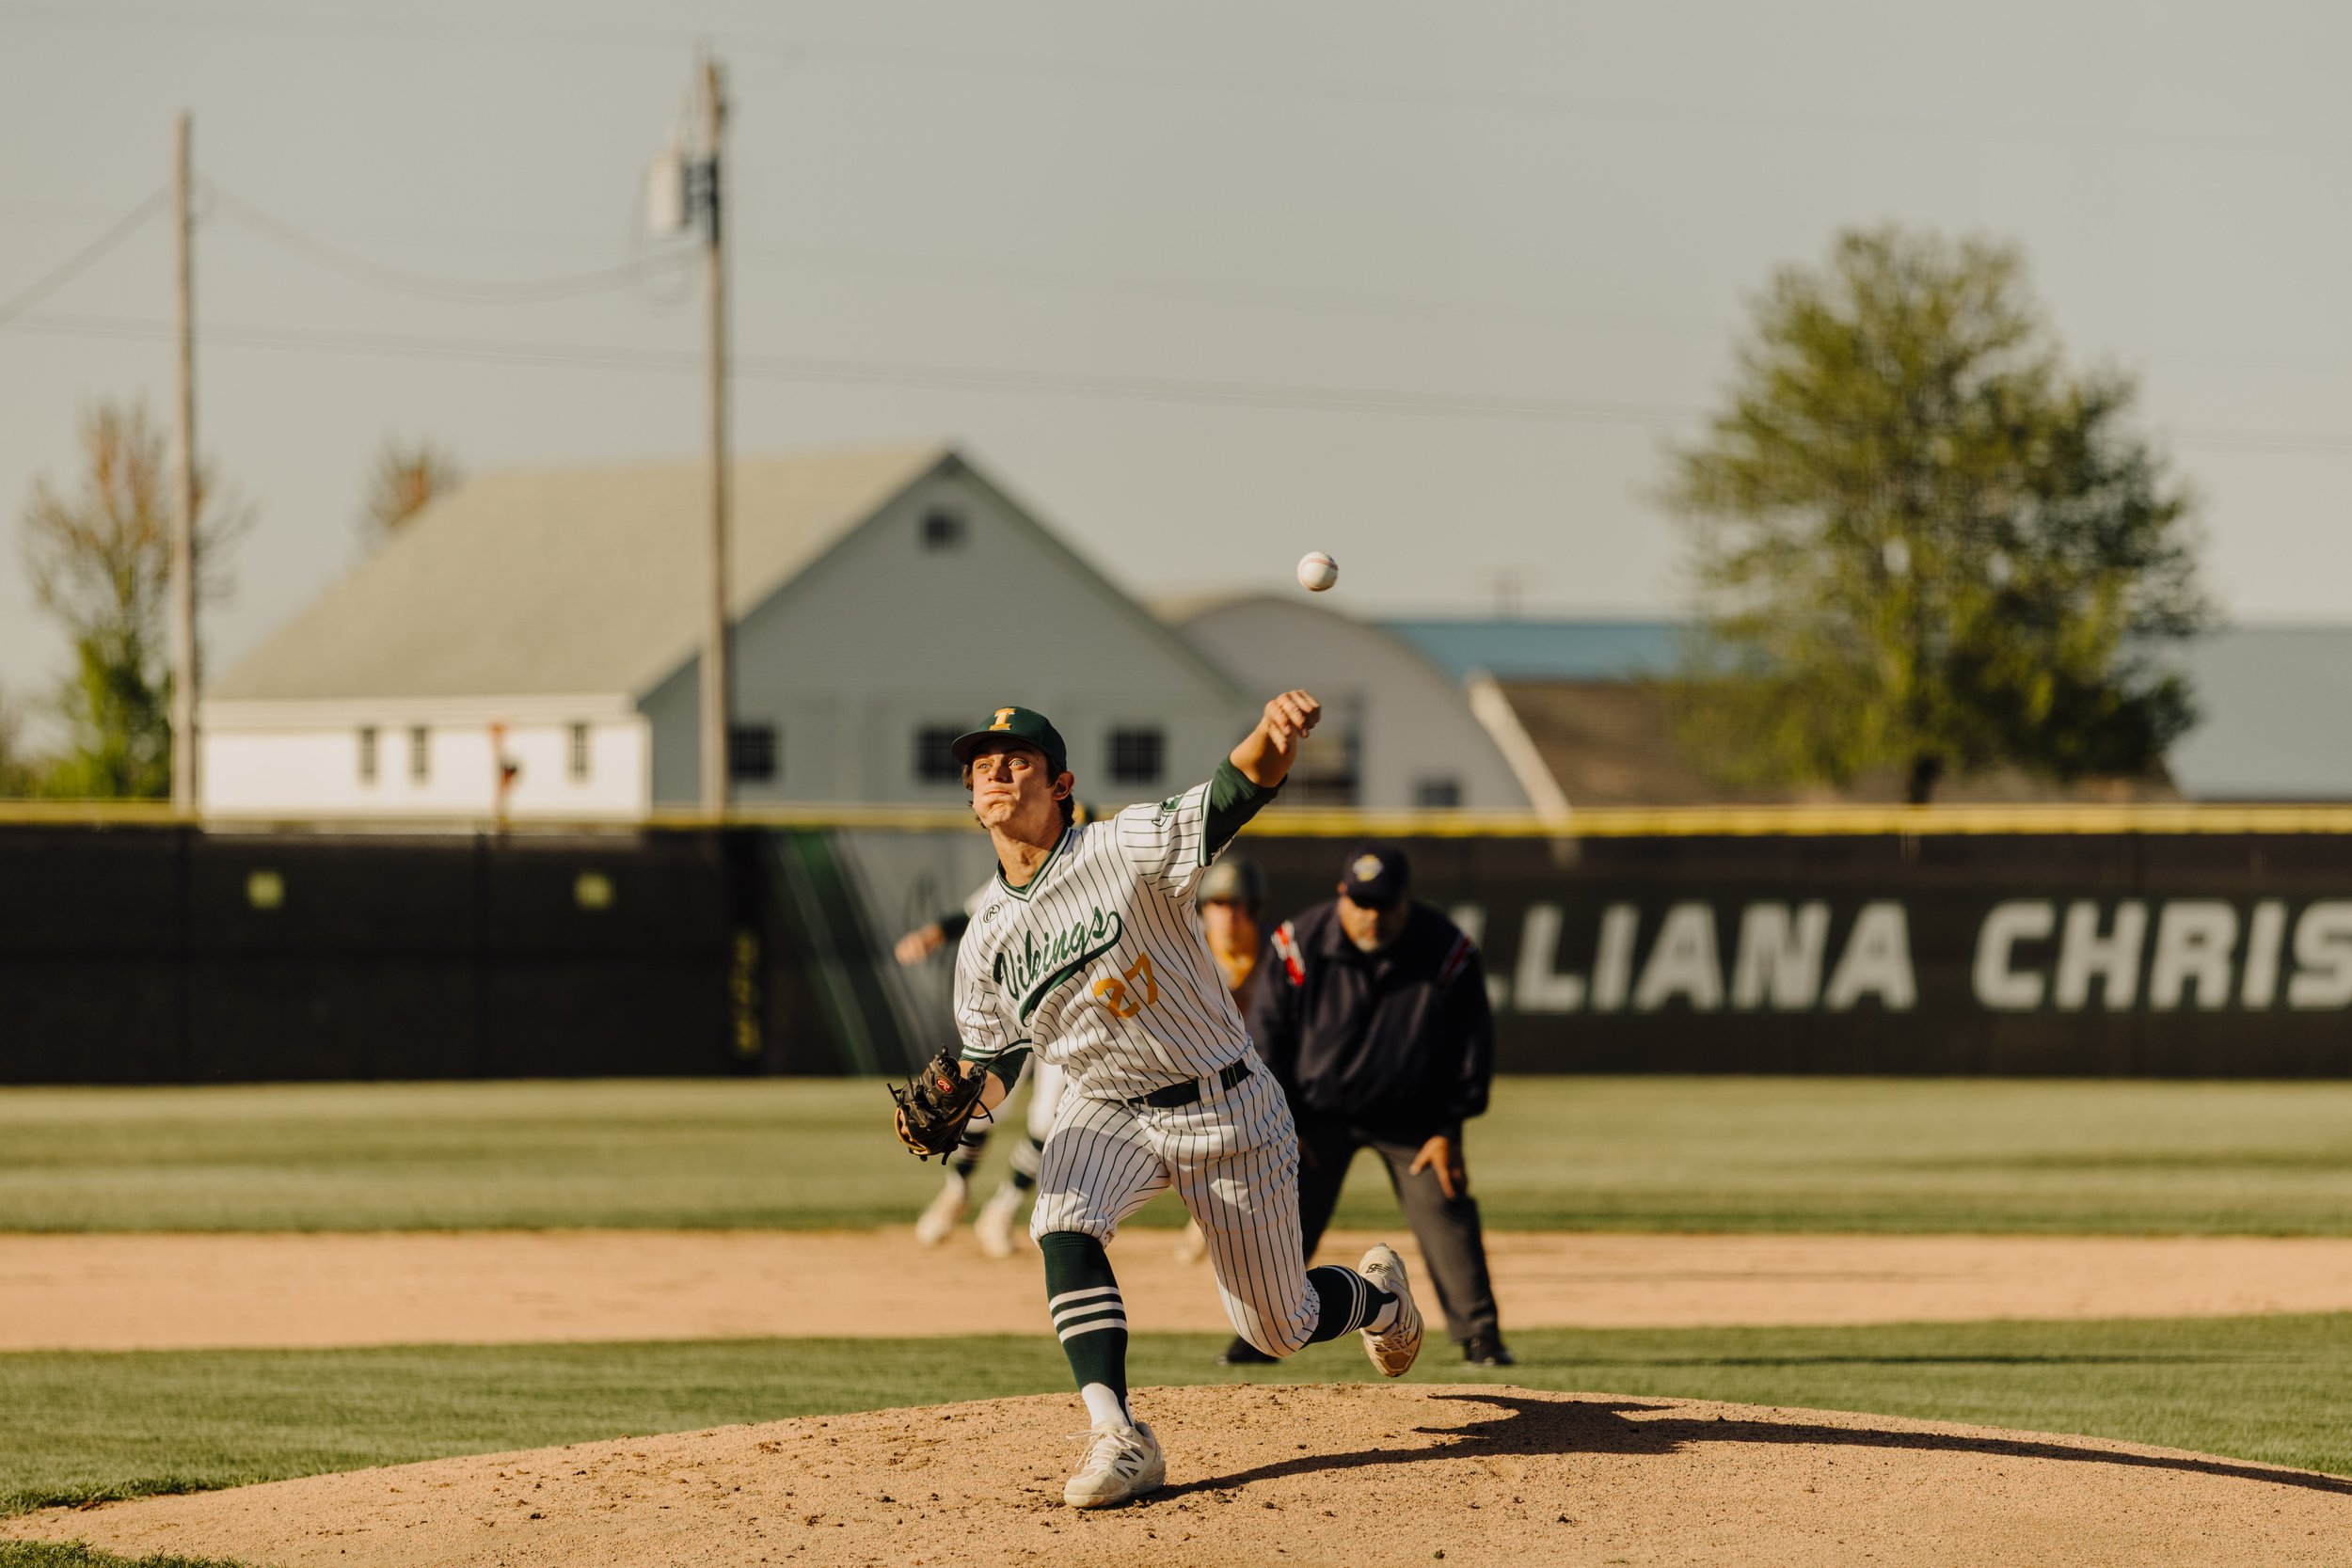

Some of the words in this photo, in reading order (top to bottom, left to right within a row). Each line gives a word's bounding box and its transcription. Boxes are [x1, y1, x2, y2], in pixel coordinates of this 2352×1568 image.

[989, 707, 1016, 731] I
[993, 906, 1121, 1027] Vikings
[1092, 951, 1158, 1020] 27
[1972, 899, 2352, 1011] CHRIS
